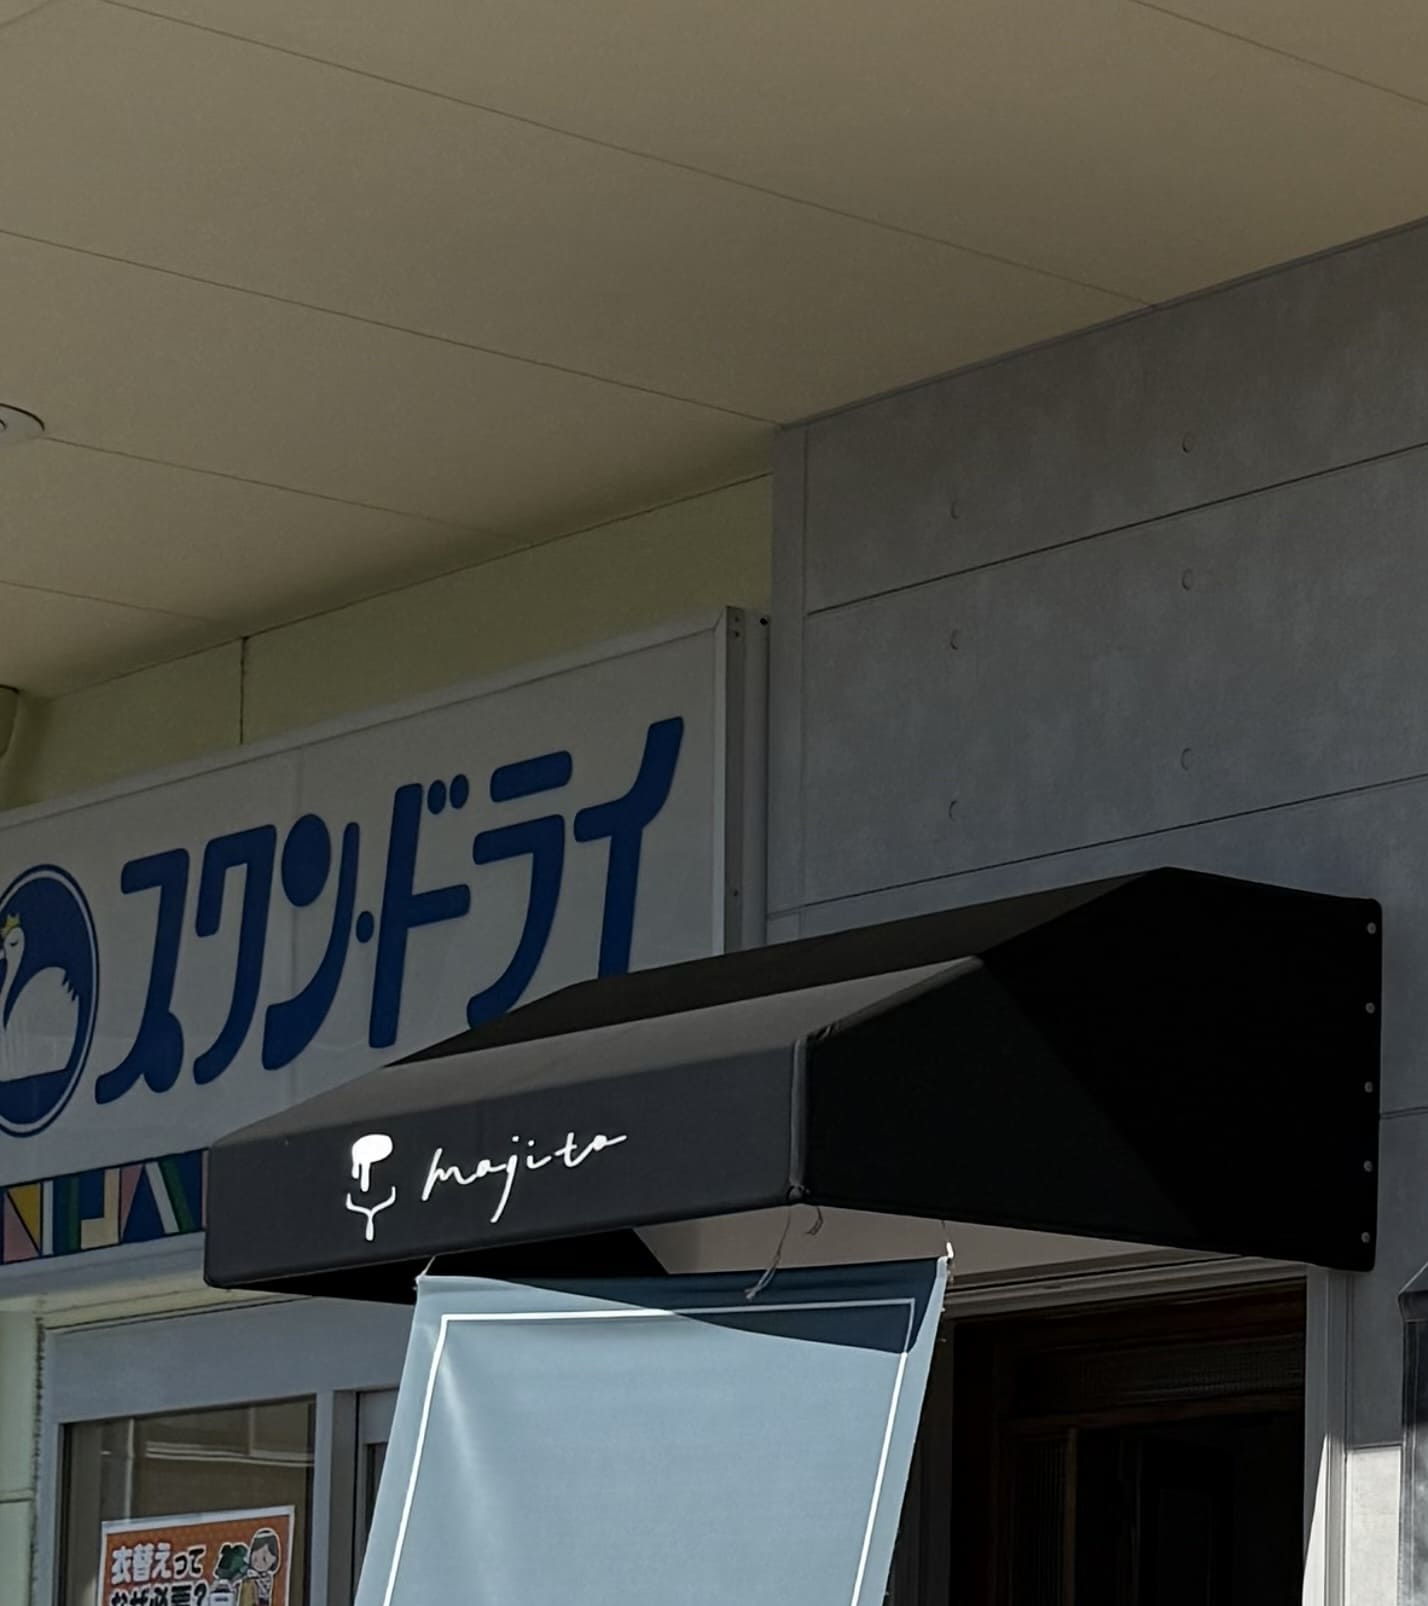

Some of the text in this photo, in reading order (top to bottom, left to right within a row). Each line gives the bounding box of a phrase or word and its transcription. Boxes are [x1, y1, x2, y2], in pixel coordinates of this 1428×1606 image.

[111, 1542, 207, 1584] 衣替えって
